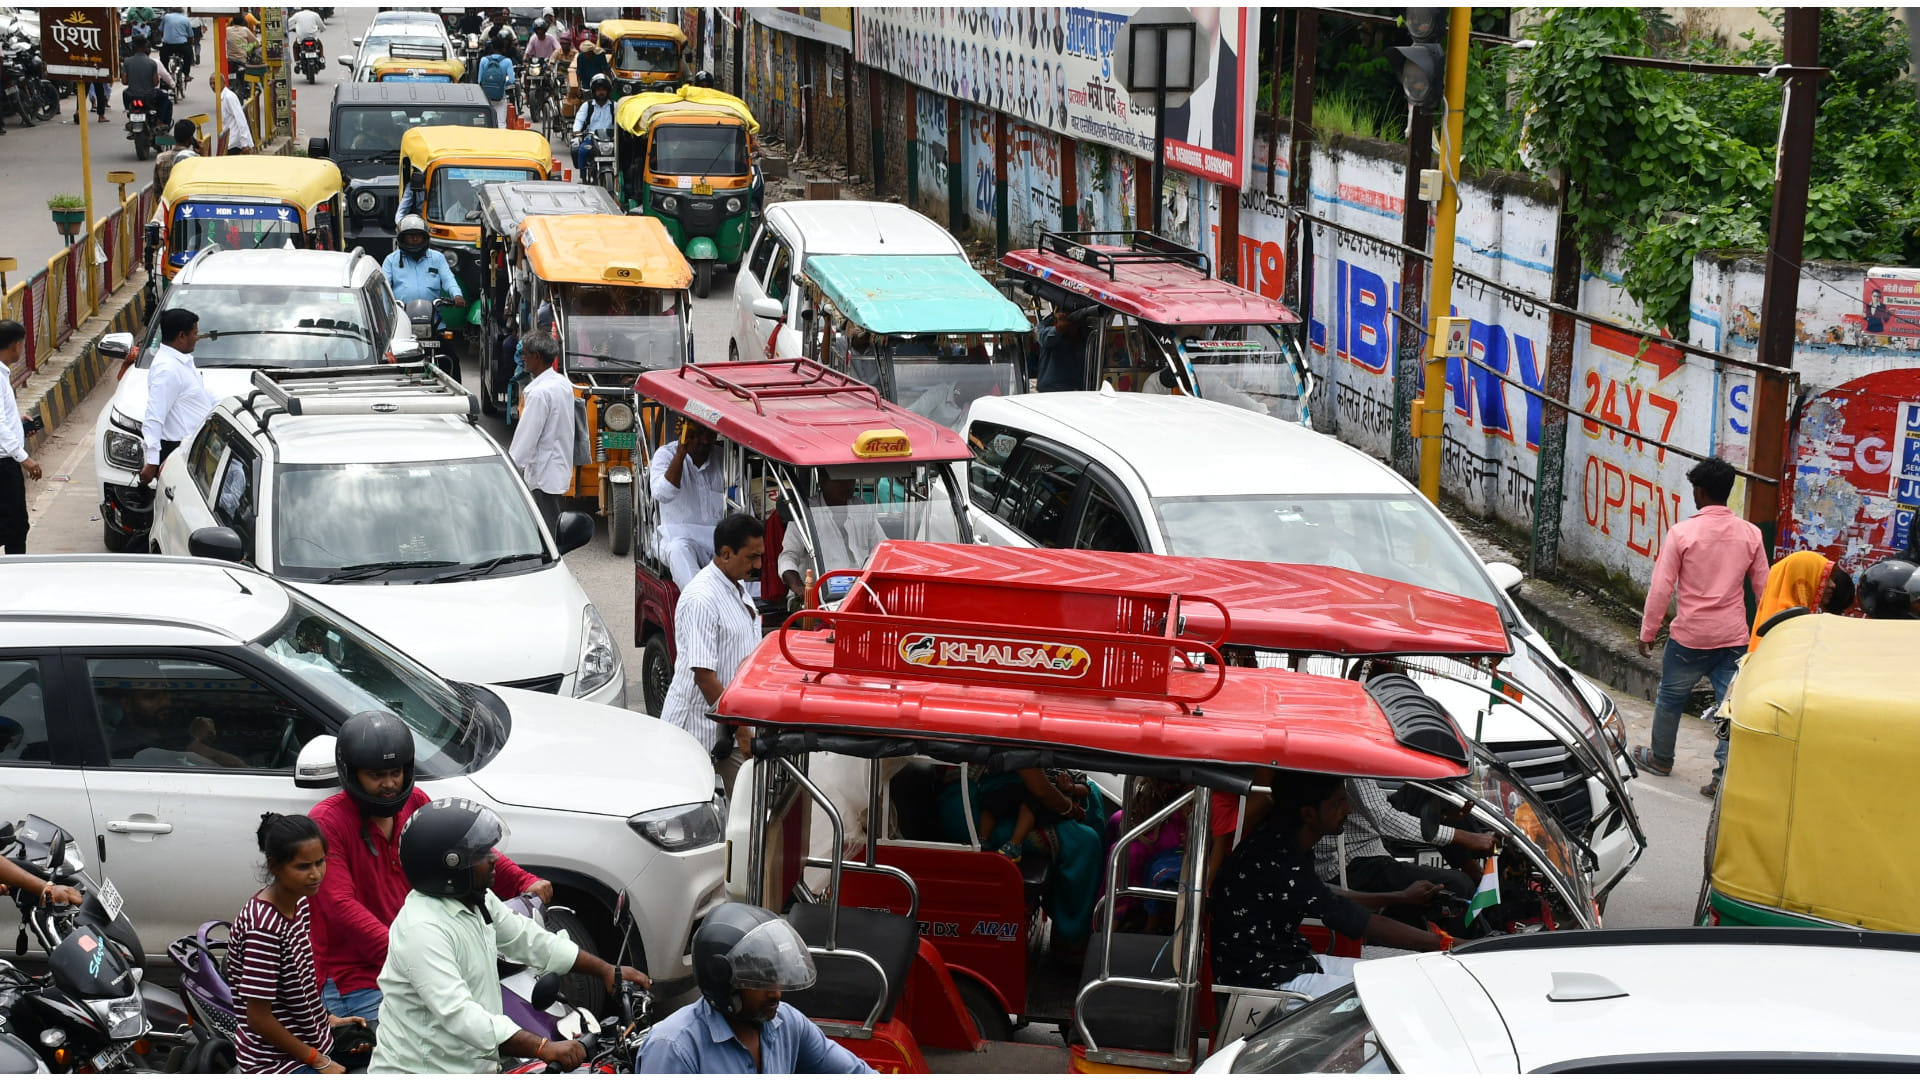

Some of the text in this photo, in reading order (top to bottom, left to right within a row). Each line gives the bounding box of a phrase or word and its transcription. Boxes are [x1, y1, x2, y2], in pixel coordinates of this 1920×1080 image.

[1103, 86, 1117, 115] पद
[239, 207, 255, 216] DAD
[1580, 370, 1680, 466] 24X7
[1583, 454, 1682, 564] OPEN
[938, 641, 1074, 671] KHALSA EV
[934, 922, 959, 938] DX
[971, 920, 1020, 938] ARAI
